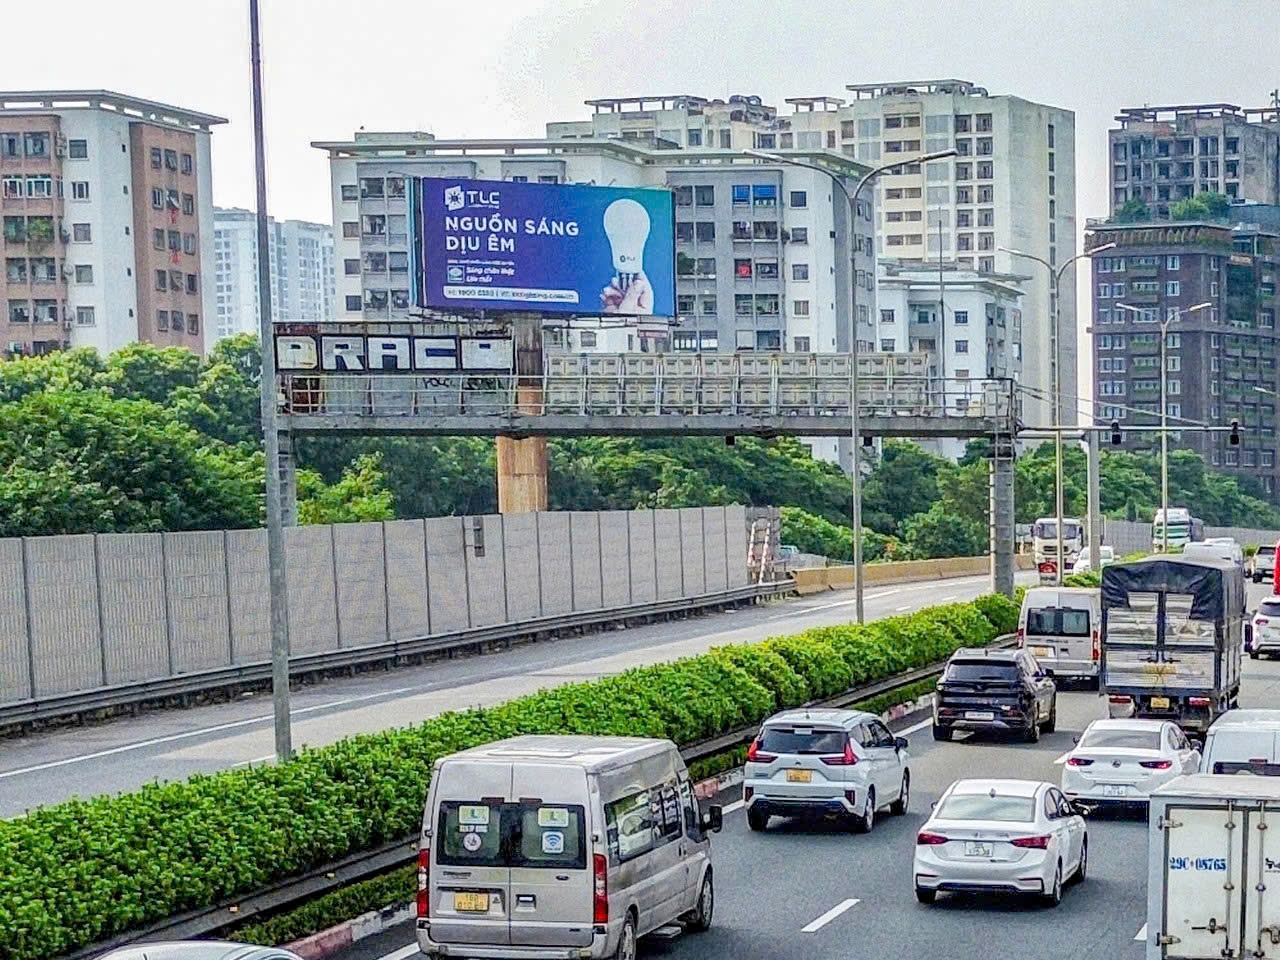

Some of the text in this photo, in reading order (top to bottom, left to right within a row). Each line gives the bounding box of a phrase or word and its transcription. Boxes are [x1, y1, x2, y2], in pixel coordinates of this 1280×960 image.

[467, 190, 500, 205] TLC
[445, 213, 579, 235] NGUỒN SÁNG
[445, 233, 515, 255] DỊU ÊM
